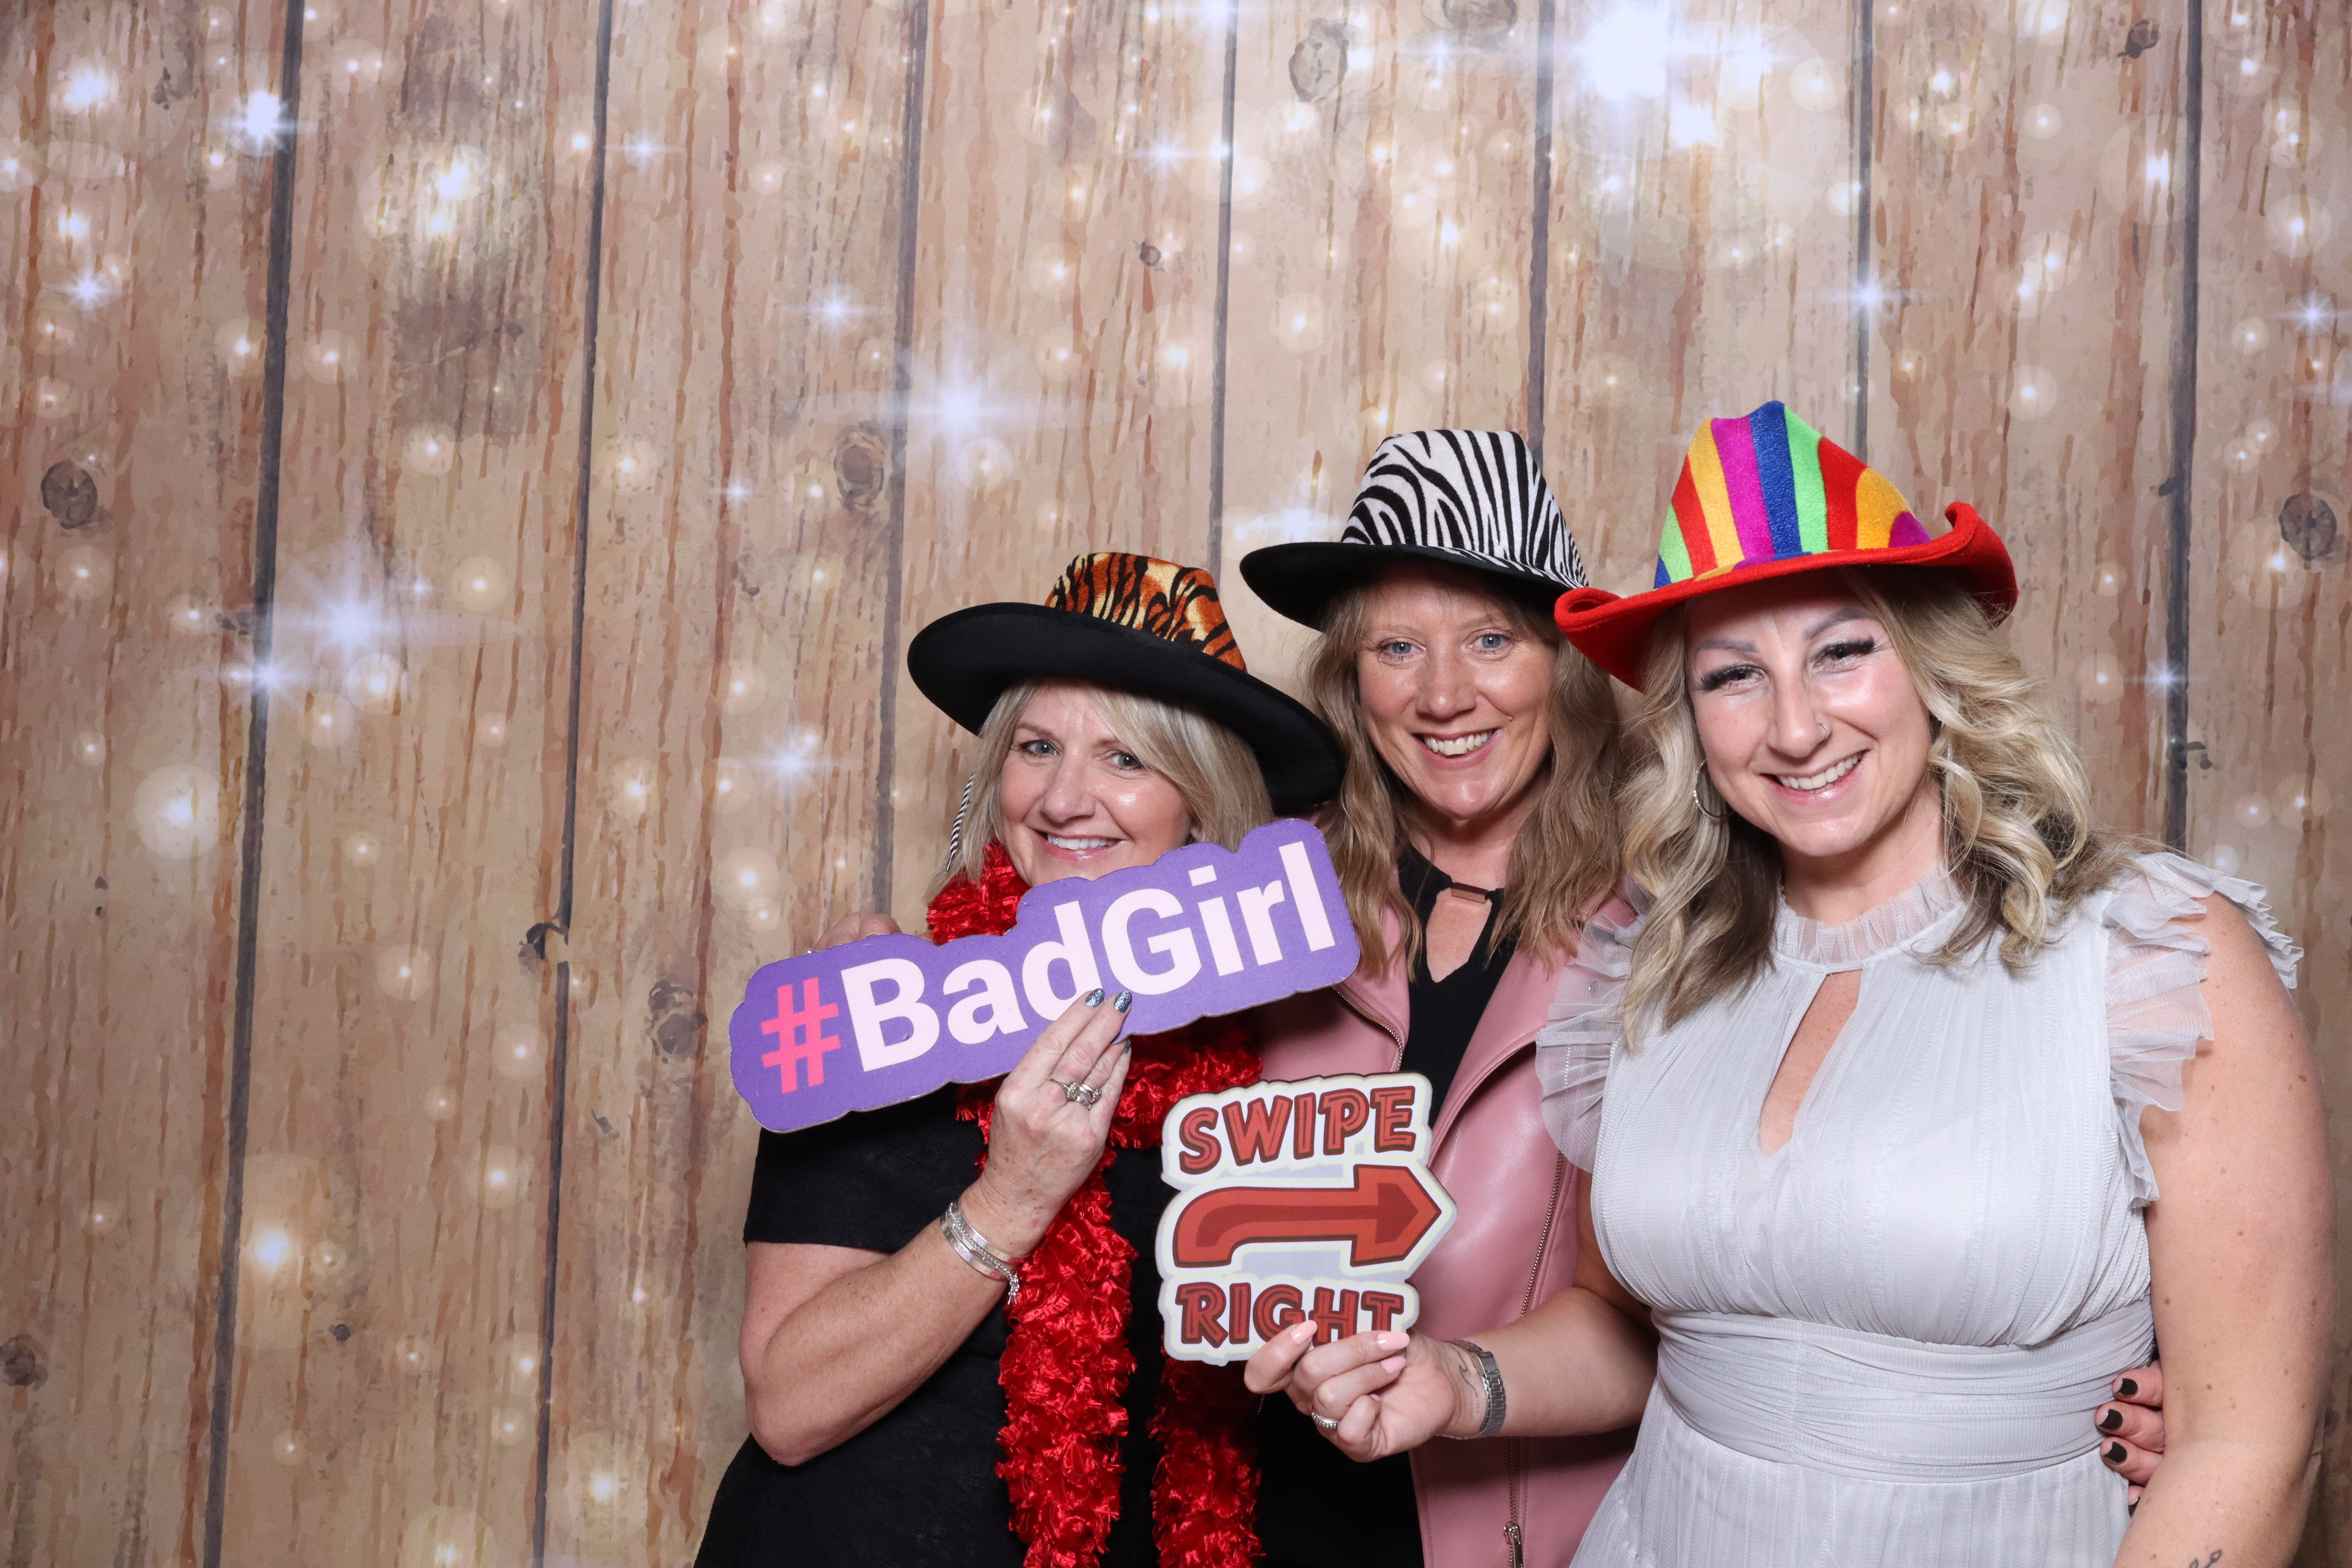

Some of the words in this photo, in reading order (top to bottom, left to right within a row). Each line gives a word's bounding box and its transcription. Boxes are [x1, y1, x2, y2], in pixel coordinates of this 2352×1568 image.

[761, 841, 1335, 1094] #BadGirl
[1179, 1085, 1416, 1174] SWIPE
[1175, 1282, 1404, 1348] RIGHT
